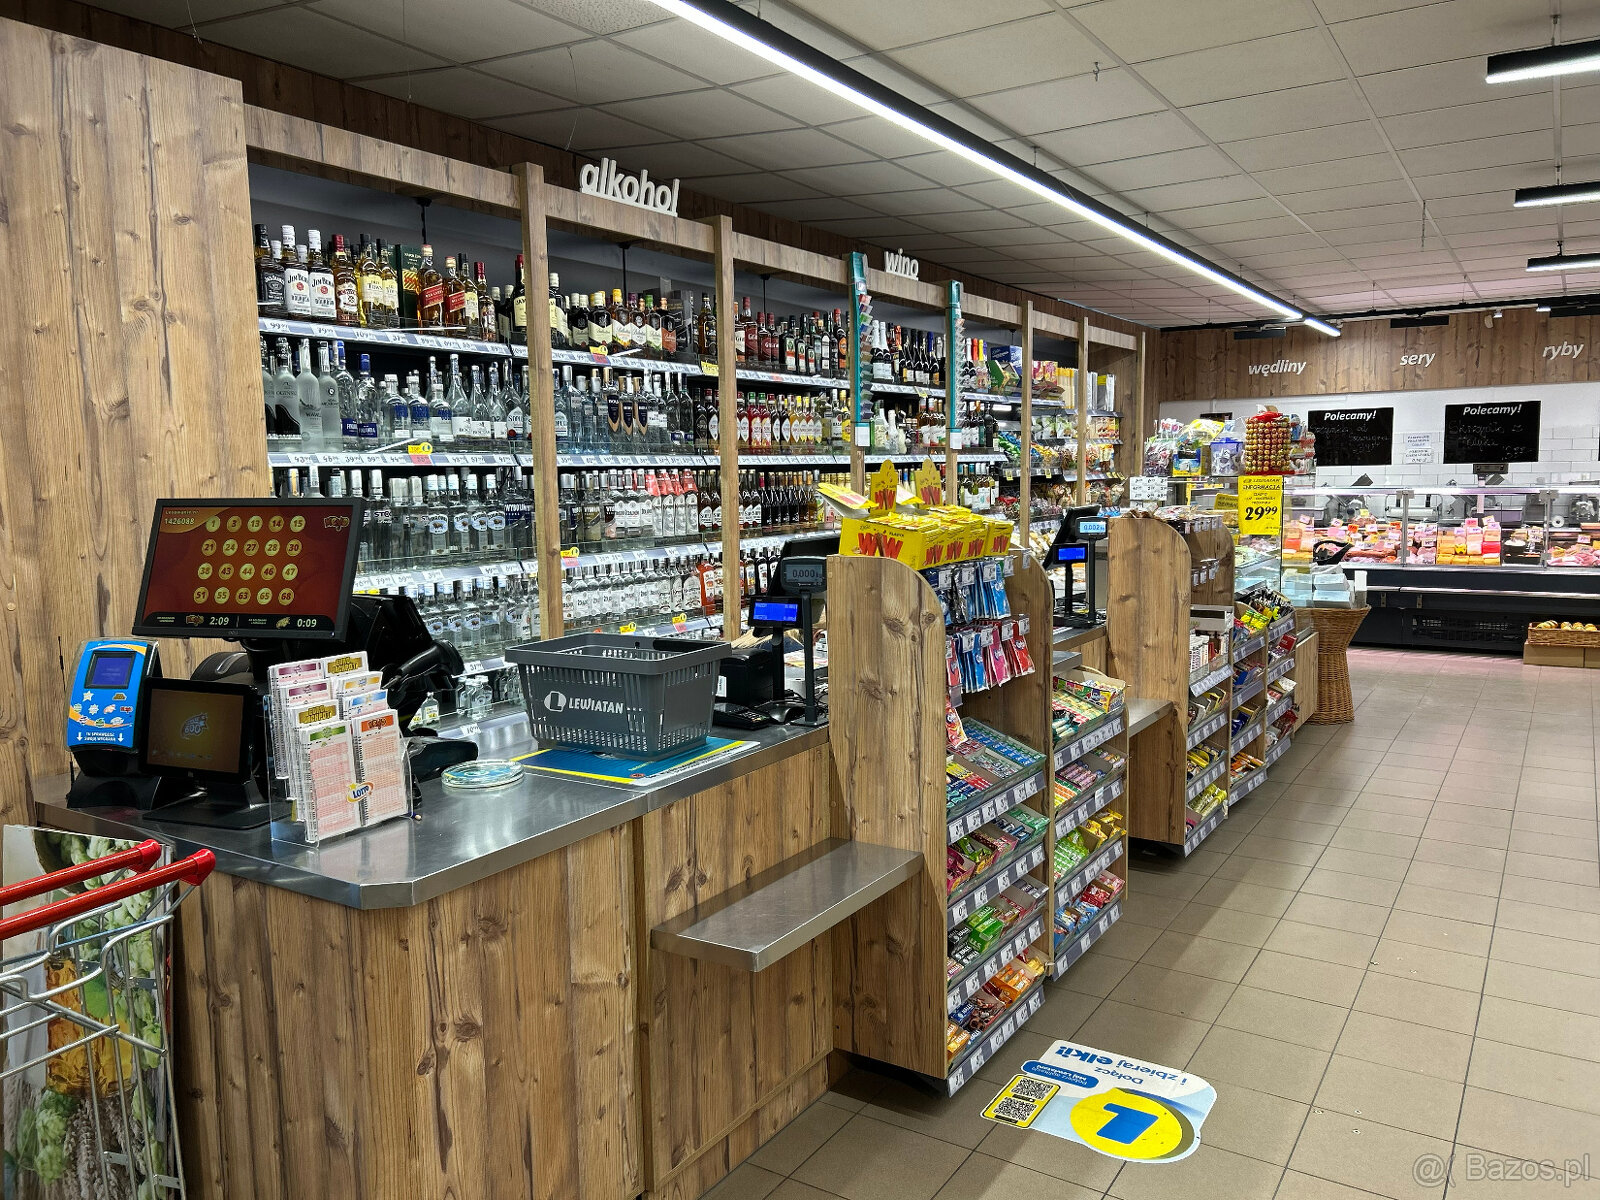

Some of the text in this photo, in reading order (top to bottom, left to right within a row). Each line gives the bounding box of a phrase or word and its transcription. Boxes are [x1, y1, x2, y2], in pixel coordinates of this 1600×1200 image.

[580, 157, 680, 217] alkohol
[885, 247, 919, 281] wino
[1542, 341, 1584, 361] ryby
[1400, 351, 1435, 368] sery
[1248, 359, 1307, 377] wędliny
[1324, 410, 1377, 421] Polecamy!
[1463, 404, 1522, 416] Polecamy!
[293, 519, 303, 527] 15
[204, 543, 299, 551] 21 24 27 28 30
[221, 567, 231, 575] 43
[241, 567, 252, 575] 44
[263, 567, 274, 575] 46
[285, 567, 295, 575] 47
[196, 591, 292, 600] 51 55 63 65 68
[209, 616, 230, 626] 2:09
[297, 618, 317, 628] 0:09
[569, 696, 624, 715] LEWIATAN
[352, 785, 370, 799] LOTTO
[1054, 1045, 1113, 1066] elki!
[1093, 1066, 1144, 1086] Dołącz
[1115, 1059, 1179, 1082] zbieraj
